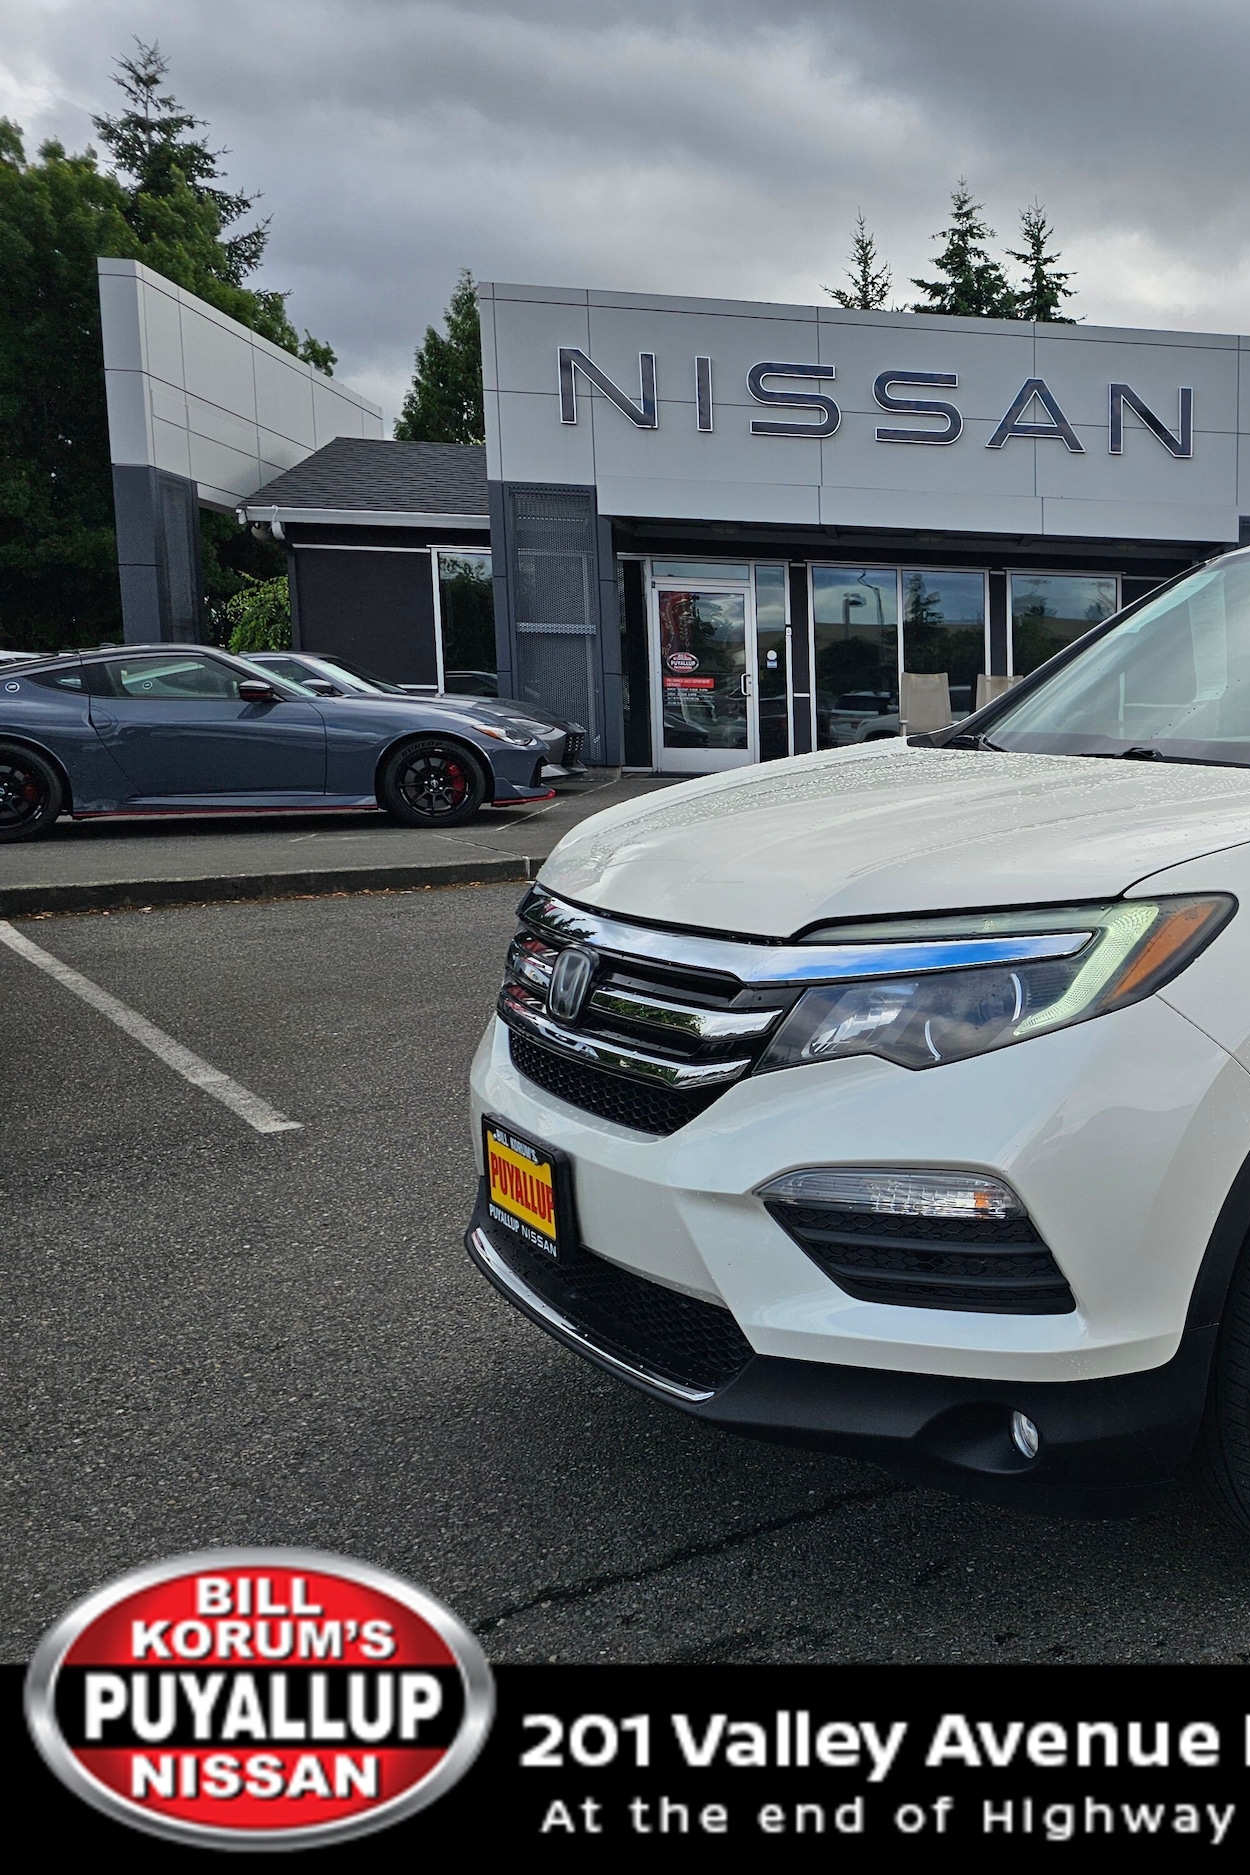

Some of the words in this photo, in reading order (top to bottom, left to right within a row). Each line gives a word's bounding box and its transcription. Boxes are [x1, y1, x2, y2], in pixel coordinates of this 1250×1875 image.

[557, 346, 1194, 459] NISSAN
[401, 741, 443, 757] DUNLOP
[496, 1128, 509, 1147] BILL
[490, 1151, 554, 1225] PUYALLUP
[489, 1202, 520, 1233] PUYALLUP
[521, 1224, 557, 1258] NISSAN
